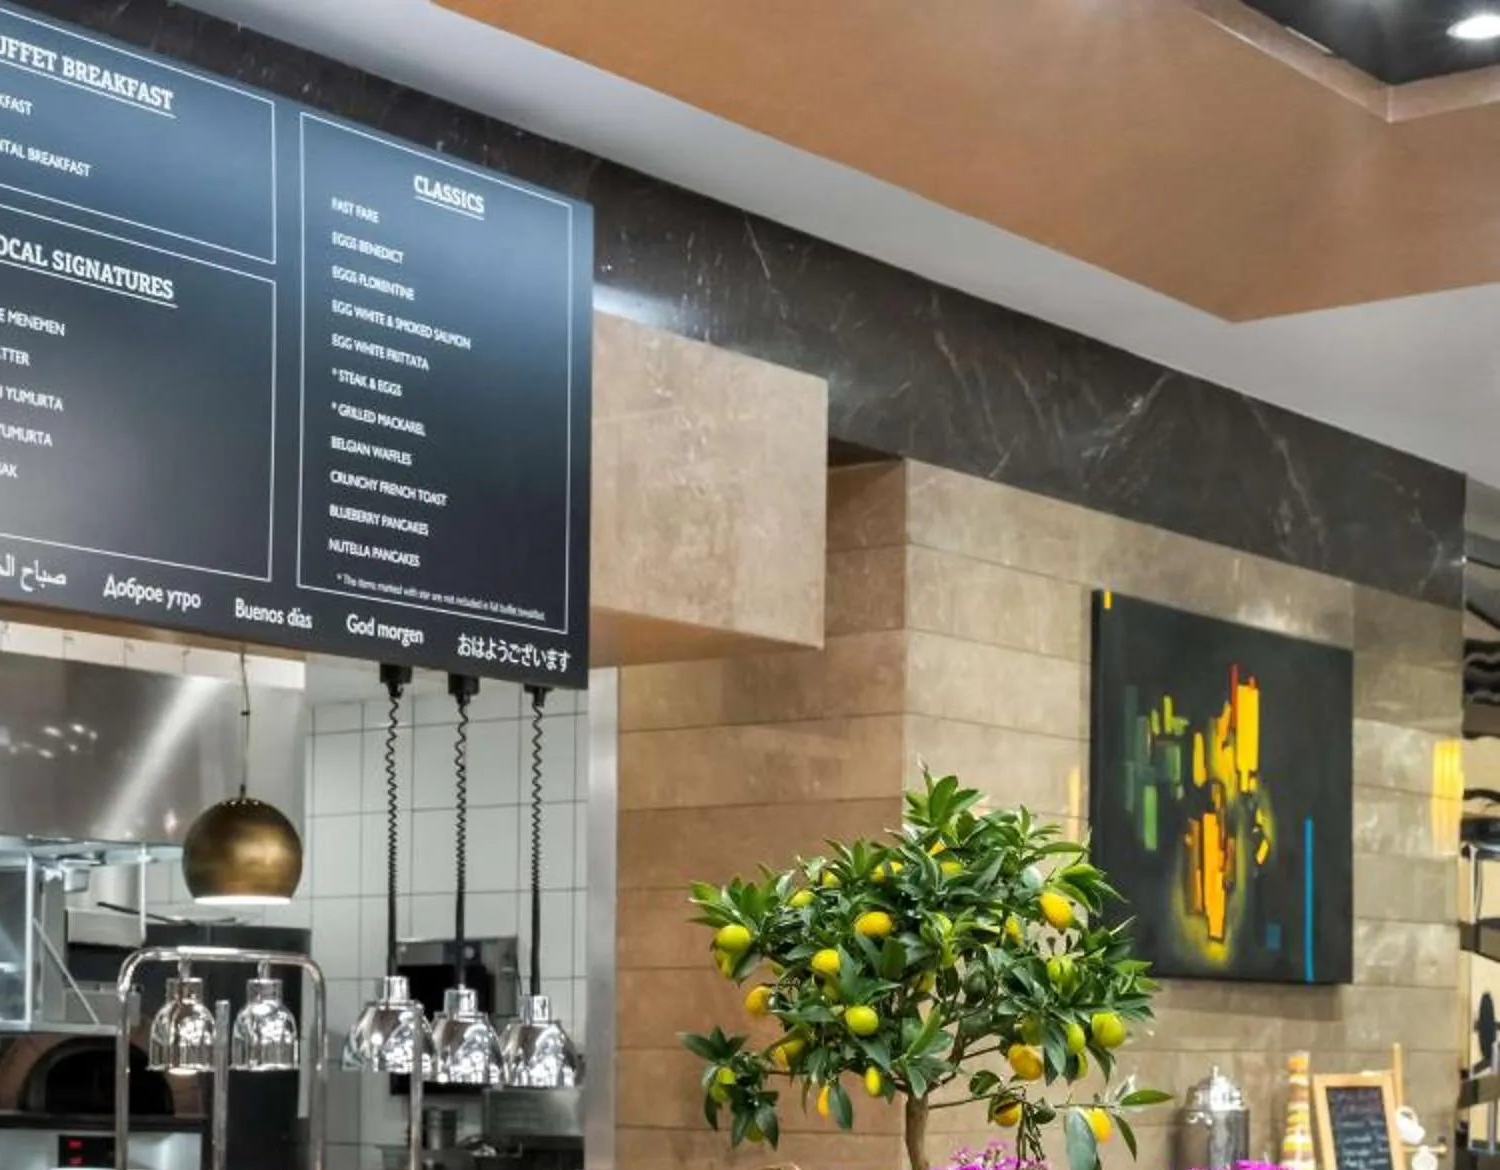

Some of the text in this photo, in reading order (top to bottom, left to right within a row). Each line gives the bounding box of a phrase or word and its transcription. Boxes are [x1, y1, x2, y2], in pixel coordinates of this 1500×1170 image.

[62, 56, 174, 108] BREAKFAST
[27, 147, 92, 176] BREAKFAST
[52, 250, 174, 298] SIGNATURES
[7, 310, 65, 335] MENEMEN
[4, 386, 65, 410] YUMURTA
[21, 559, 67, 592] صباح
[104, 575, 200, 611] Доброе утро
[235, 597, 284, 625] Buenos
[347, 614, 423, 647] God morgen
[457, 632, 571, 673] おはようございます
